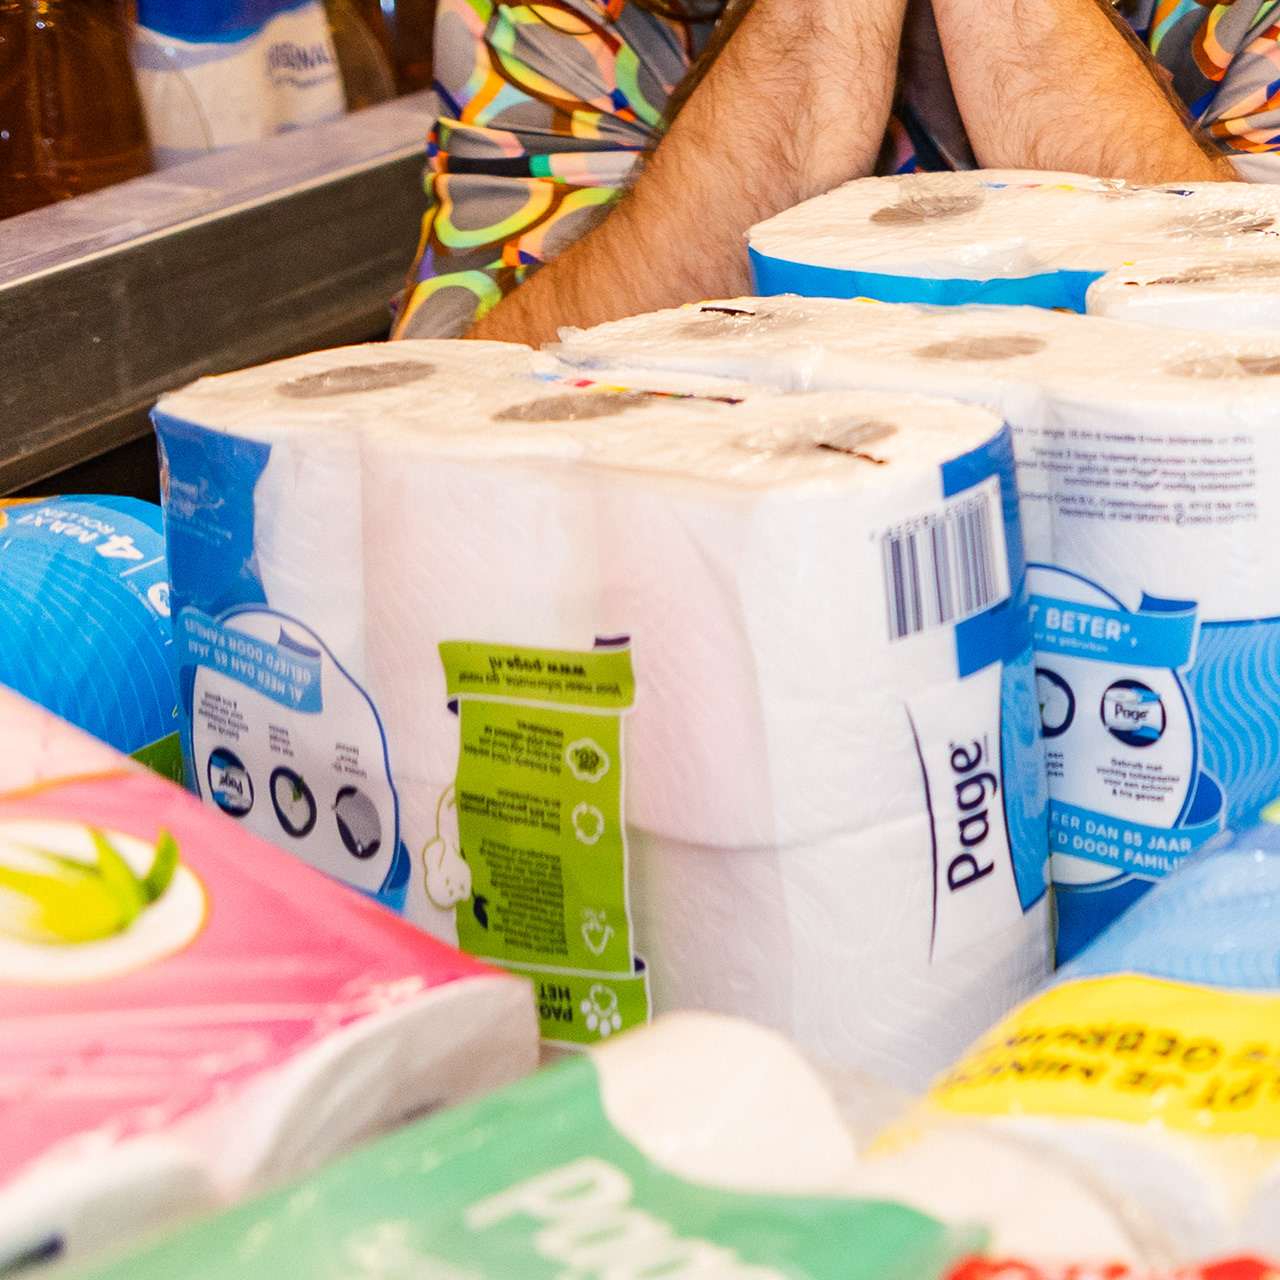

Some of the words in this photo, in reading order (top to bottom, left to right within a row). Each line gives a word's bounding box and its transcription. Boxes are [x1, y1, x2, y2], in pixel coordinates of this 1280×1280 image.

[1114, 703, 1148, 723] Page
[947, 738, 999, 893] Page
[1072, 835, 1120, 860] DOOR
[1085, 820, 1119, 840] DAN
[1123, 829, 1143, 848] 85
[1147, 835, 1193, 853] JAAR
